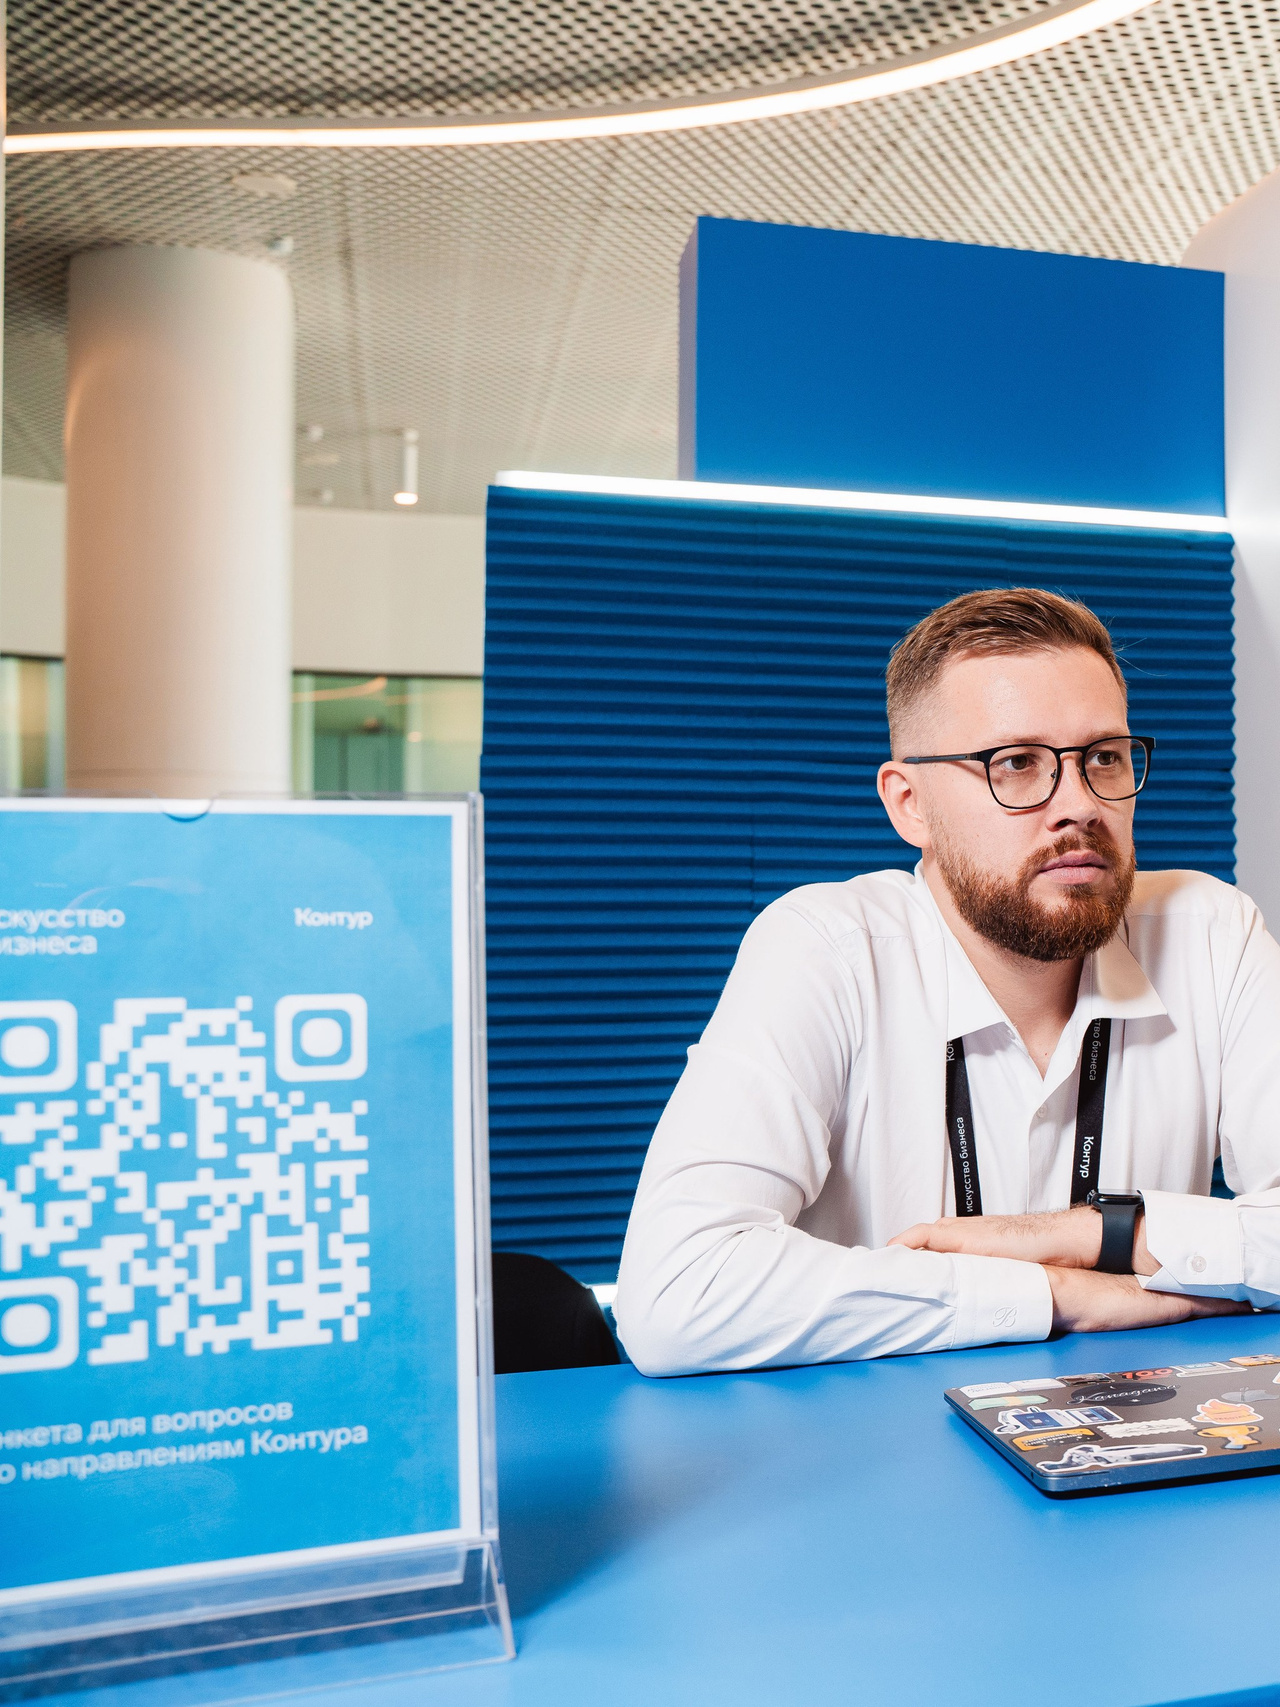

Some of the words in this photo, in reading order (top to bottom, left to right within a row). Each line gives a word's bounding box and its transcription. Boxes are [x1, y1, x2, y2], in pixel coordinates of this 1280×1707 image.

[293, 907, 374, 930] Контур
[1089, 1040, 1102, 1081] бизнеса
[956, 1116, 969, 1160] бизнеса
[1079, 1136, 1094, 1178] Контур
[963, 1160, 974, 1213] искусство
[88, 1416, 146, 1443] для
[152, 1401, 293, 1433] вопросов
[21, 1437, 246, 1480] направлениям
[250, 1425, 368, 1454] Контура
